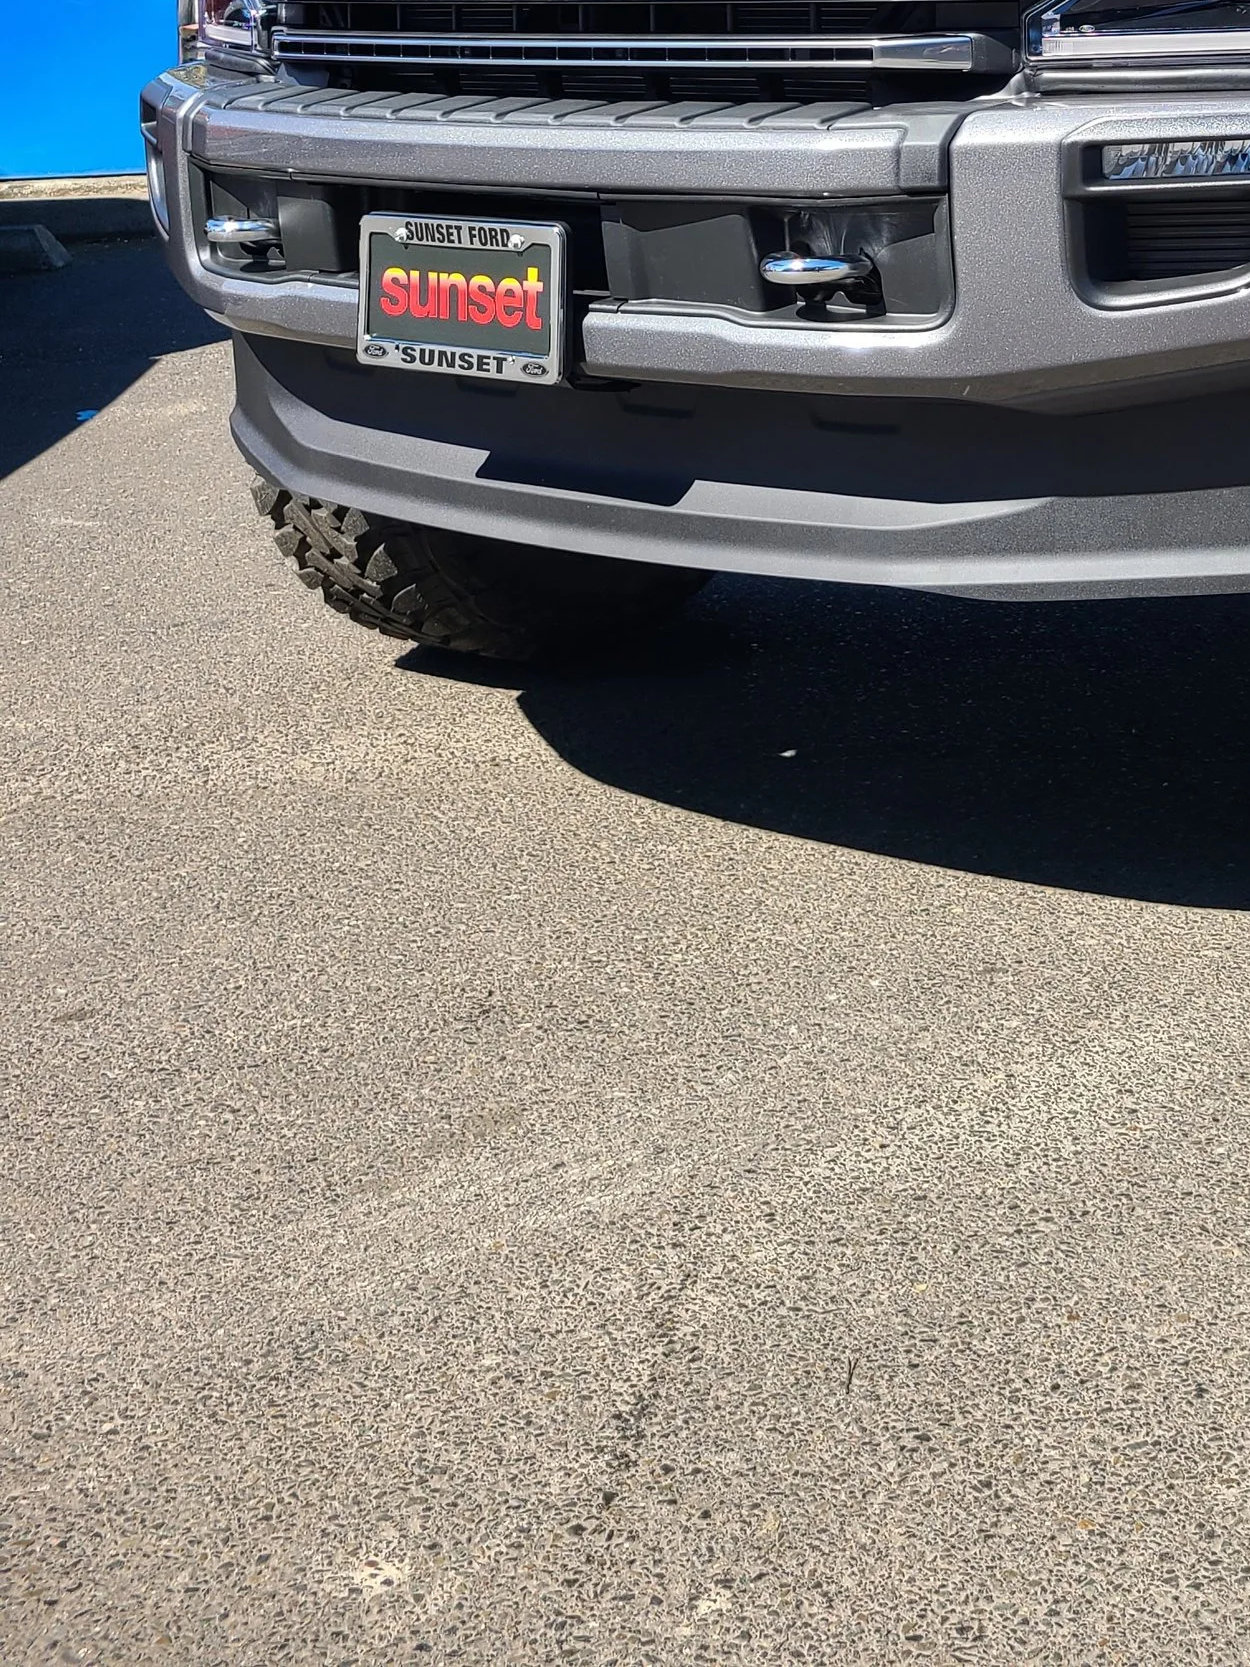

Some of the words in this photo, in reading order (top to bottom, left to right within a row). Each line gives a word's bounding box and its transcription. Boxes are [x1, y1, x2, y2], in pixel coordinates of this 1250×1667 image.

[404, 221, 463, 245] SUNSET
[469, 226, 511, 248] FORD
[380, 267, 543, 329] sunset
[402, 346, 507, 375] SUNSET
